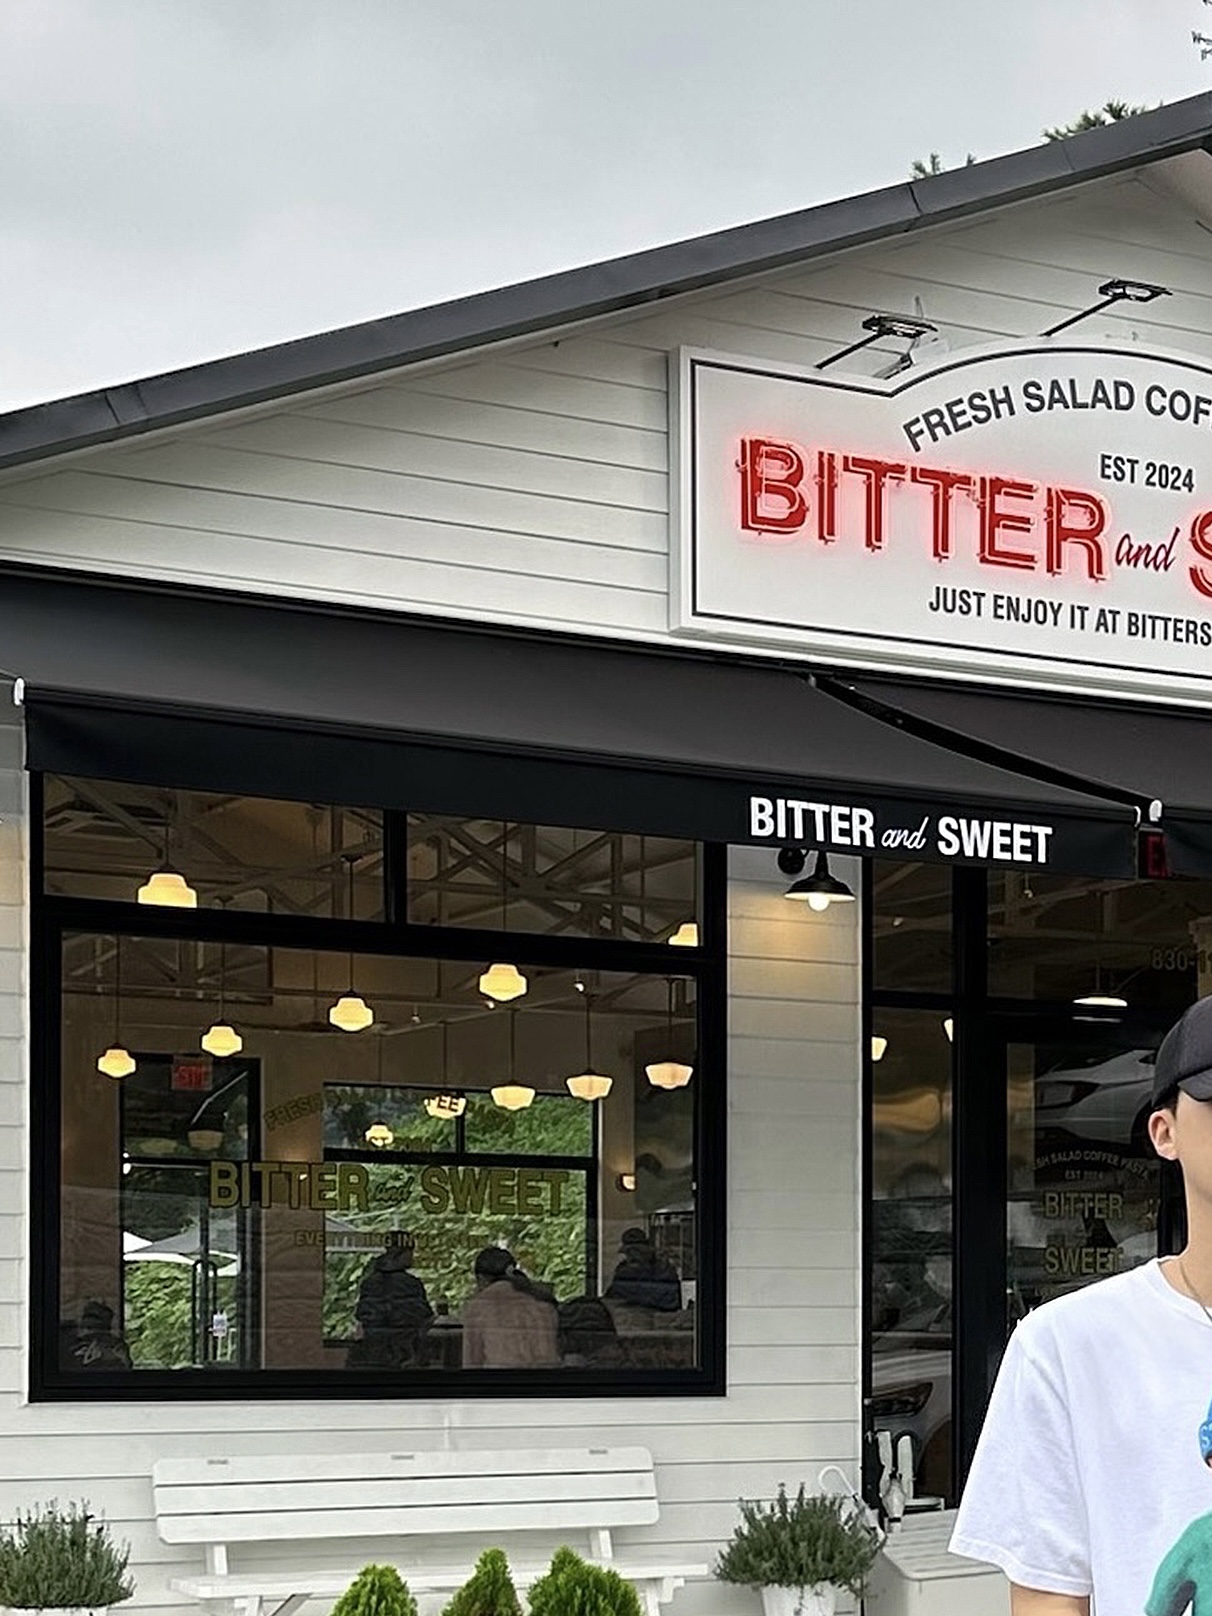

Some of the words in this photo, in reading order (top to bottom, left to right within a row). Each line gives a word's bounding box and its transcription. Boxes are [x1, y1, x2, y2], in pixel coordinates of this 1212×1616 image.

[903, 385, 1016, 453] FRESH
[1022, 378, 1135, 413] SALAD
[1100, 453, 1140, 485] EST
[1145, 462, 1195, 493] 2024
[738, 437, 1107, 581] BITTER
[1115, 527, 1181, 573] and
[928, 586, 986, 617] JUST
[993, 594, 1063, 627] ENJOY
[1070, 604, 1090, 631] IT
[1095, 608, 1121, 634] AT
[750, 796, 876, 848] BITTER
[881, 816, 929, 850] and
[937, 816, 1053, 864] SWEET
[209, 1159, 371, 1212] BITTER
[420, 1164, 570, 1216] SWEET
[1044, 1191, 1123, 1219] BITTER
[1044, 1245, 1124, 1274] SWEET
